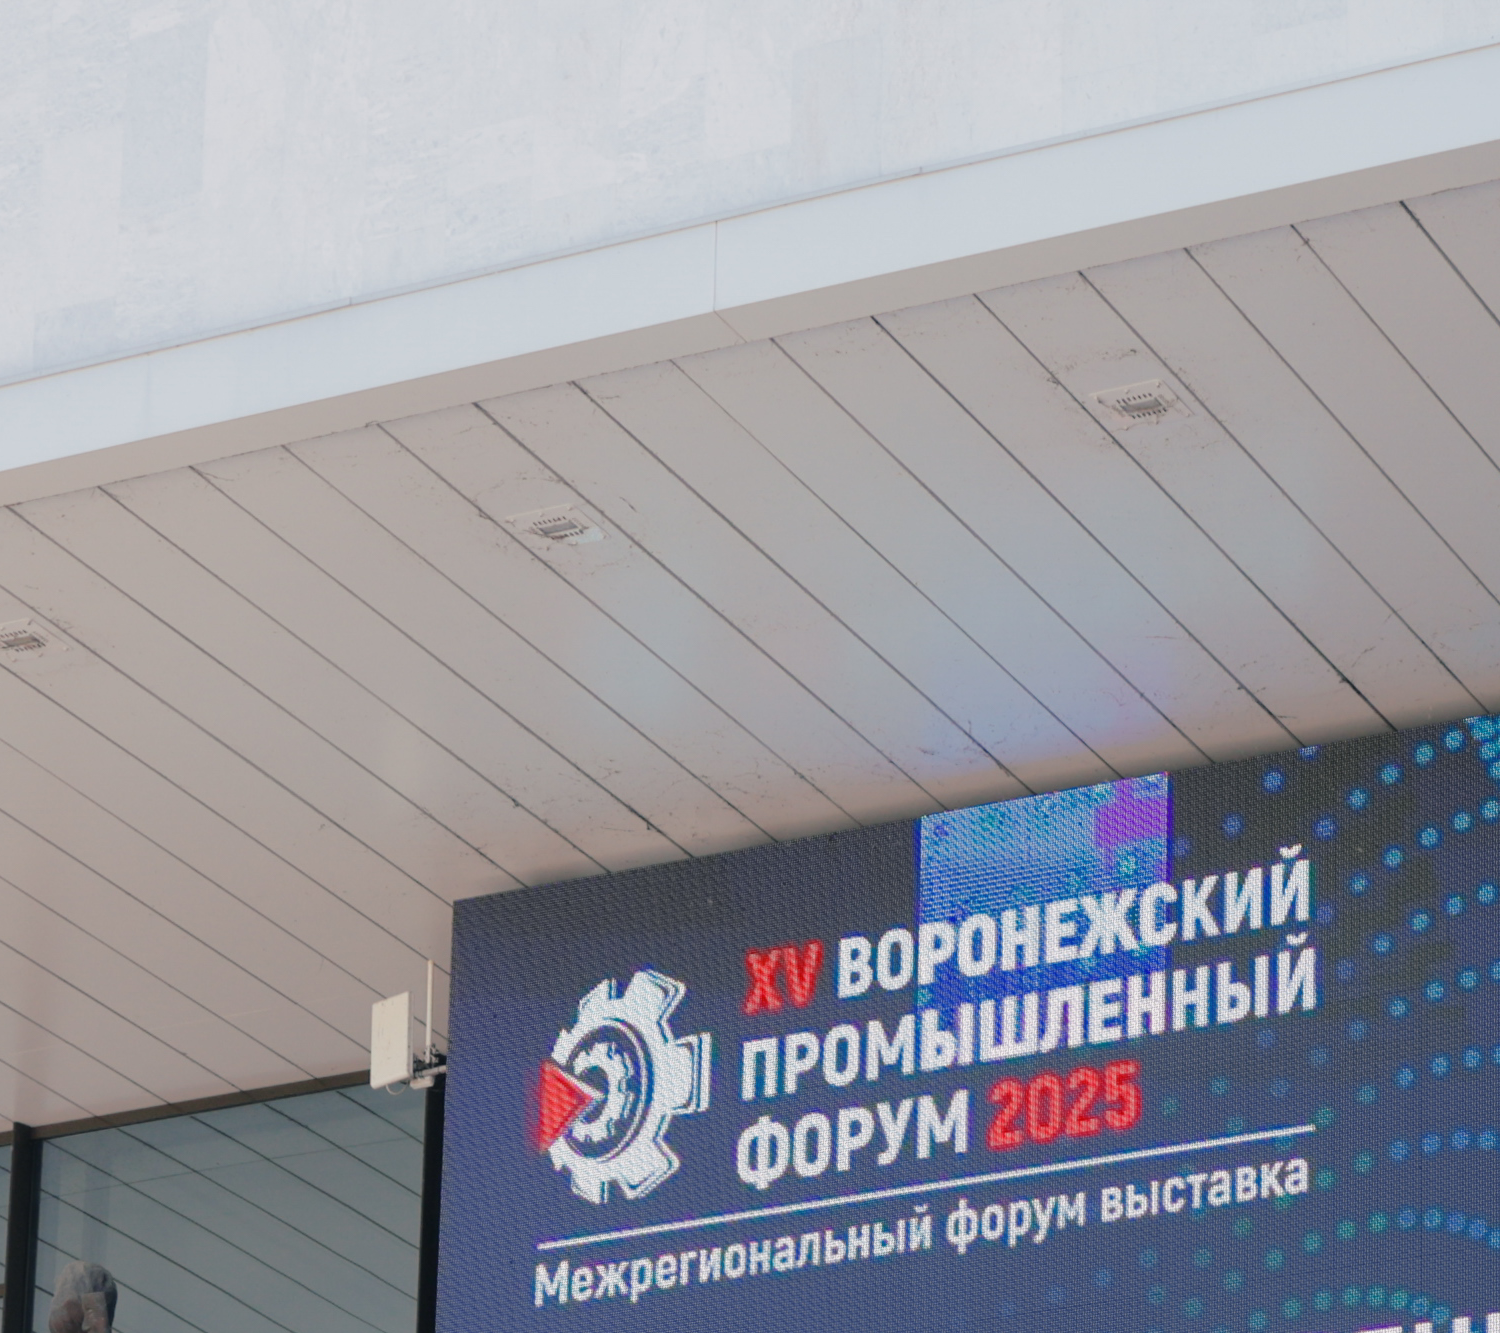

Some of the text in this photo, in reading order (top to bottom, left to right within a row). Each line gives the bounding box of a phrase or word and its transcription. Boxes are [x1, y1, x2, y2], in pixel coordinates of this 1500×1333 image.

[744, 845, 1310, 1014] XV ВОРОНЕЖСКИЙ
[742, 933, 1316, 1100] ПРОМЫШЛЕННЫЙ
[736, 1059, 1143, 1190] ФОРУМ 2025
[534, 1157, 1310, 1307] Межрегиональный форум выставка
